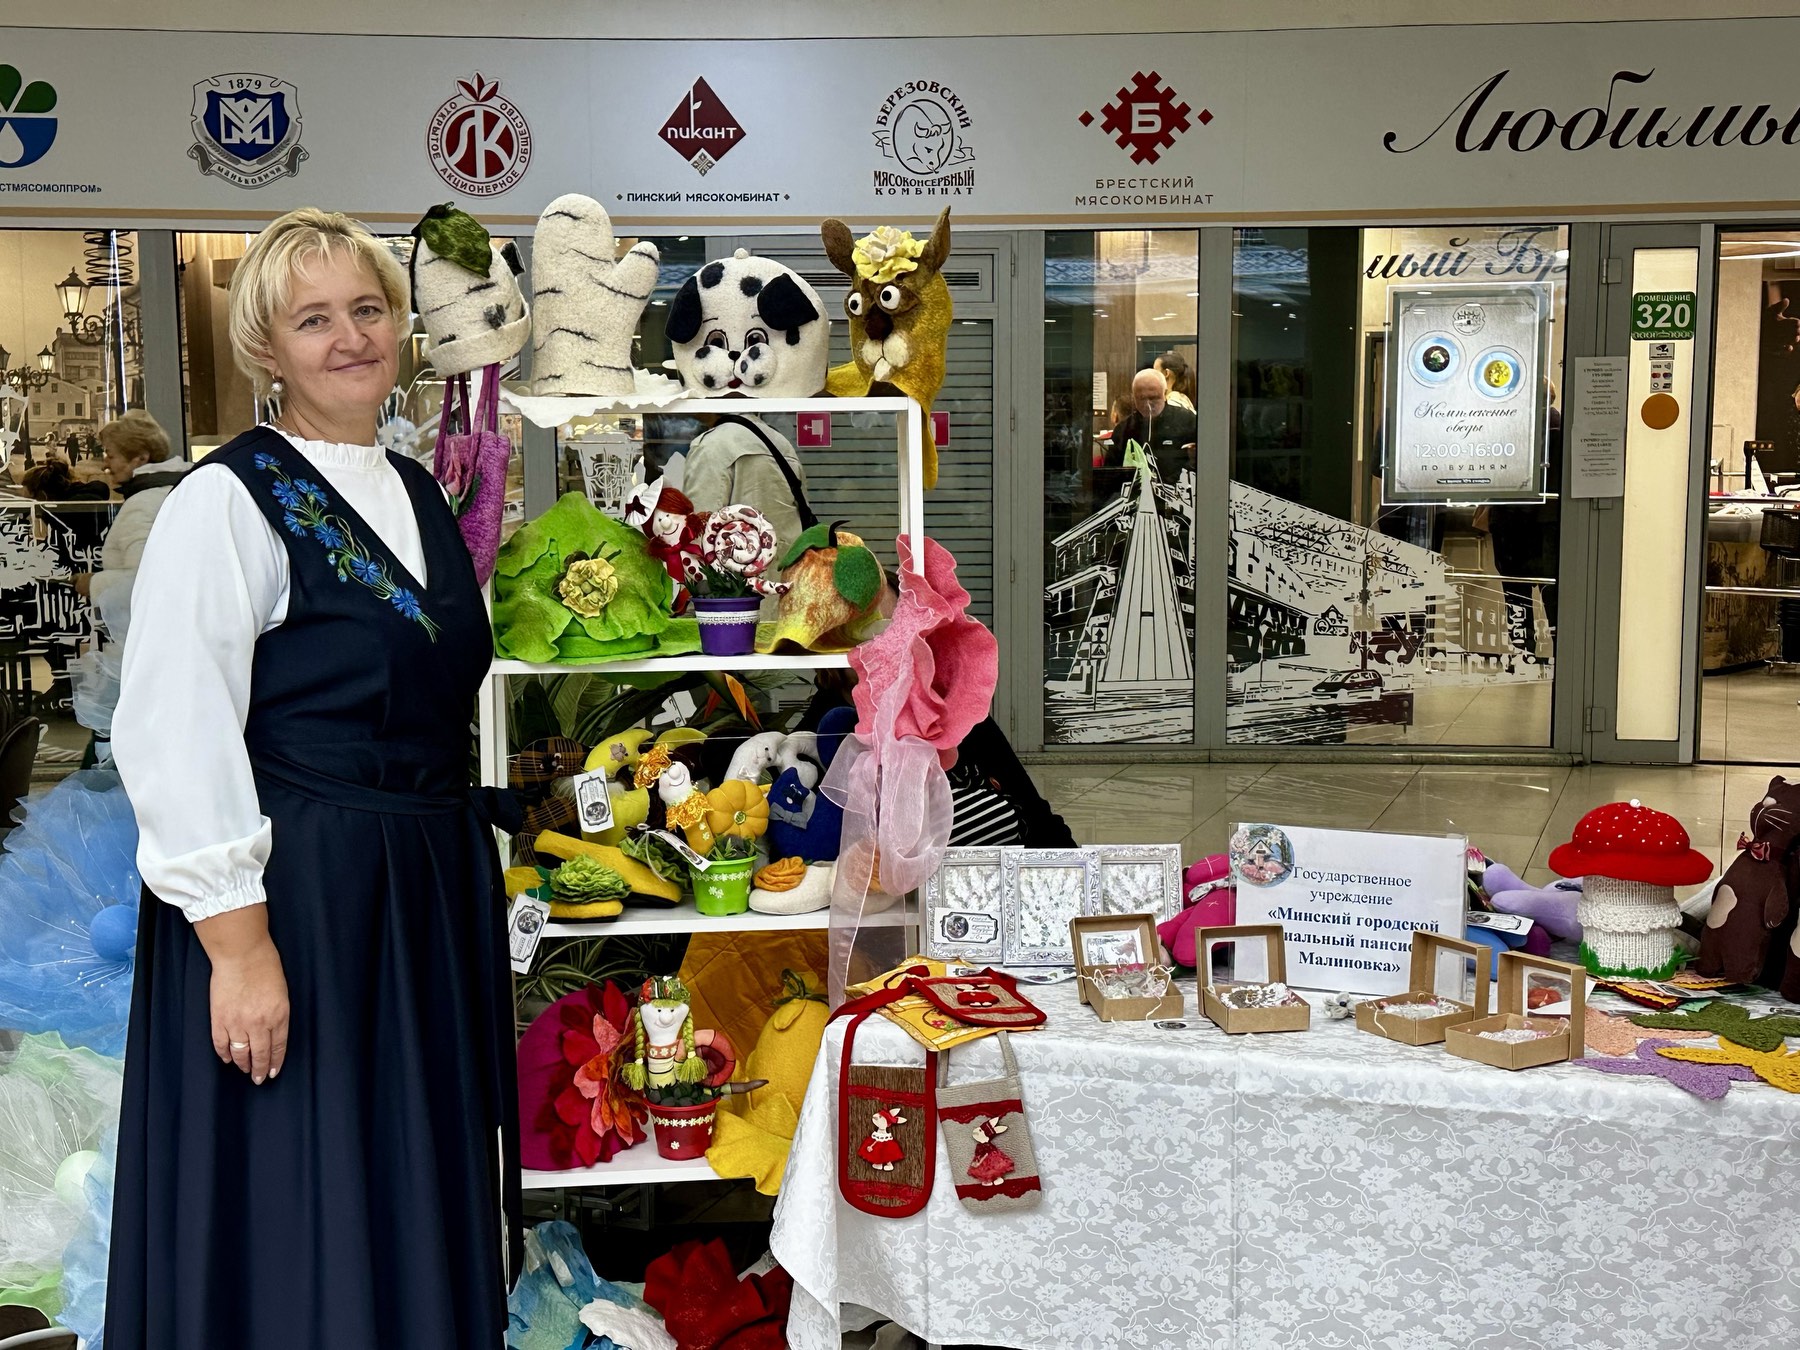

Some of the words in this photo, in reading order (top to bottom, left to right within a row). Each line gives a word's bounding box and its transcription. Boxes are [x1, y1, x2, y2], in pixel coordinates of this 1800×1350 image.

[228, 79, 262, 90] 1879
[876, 80, 973, 129] БЕРЕЗОВСКИЙ
[430, 101, 458, 160] ОТКРЫТОЕ
[499, 102, 529, 164] ОБЩЕСТВО
[440, 167, 520, 194] АКЦИОНЕРНОЕ
[1095, 176, 1194, 189] БРЕСТСКИЙ
[627, 191, 681, 202] ПИНСКИЙ
[686, 192, 780, 202] МЯСОКОМБИНАТ
[875, 187, 974, 196] КОМБИНАТ
[1075, 194, 1214, 206] МЯСОКОМБИНАТ
[1637, 294, 1691, 302] ПОМЕЩЕНИЕ
[1636, 303, 1691, 328] 320
[1414, 400, 1518, 419] Комплексные
[1445, 419, 1484, 439] обеды
[1414, 442, 1516, 458] 12:00-16:00
[1293, 866, 1412, 887] Государственное
[1309, 889, 1393, 906] учреждение
[1268, 906, 1352, 926] «Минский
[1356, 916, 1439, 933] городской
[1298, 950, 1401, 973] Малиновка»
